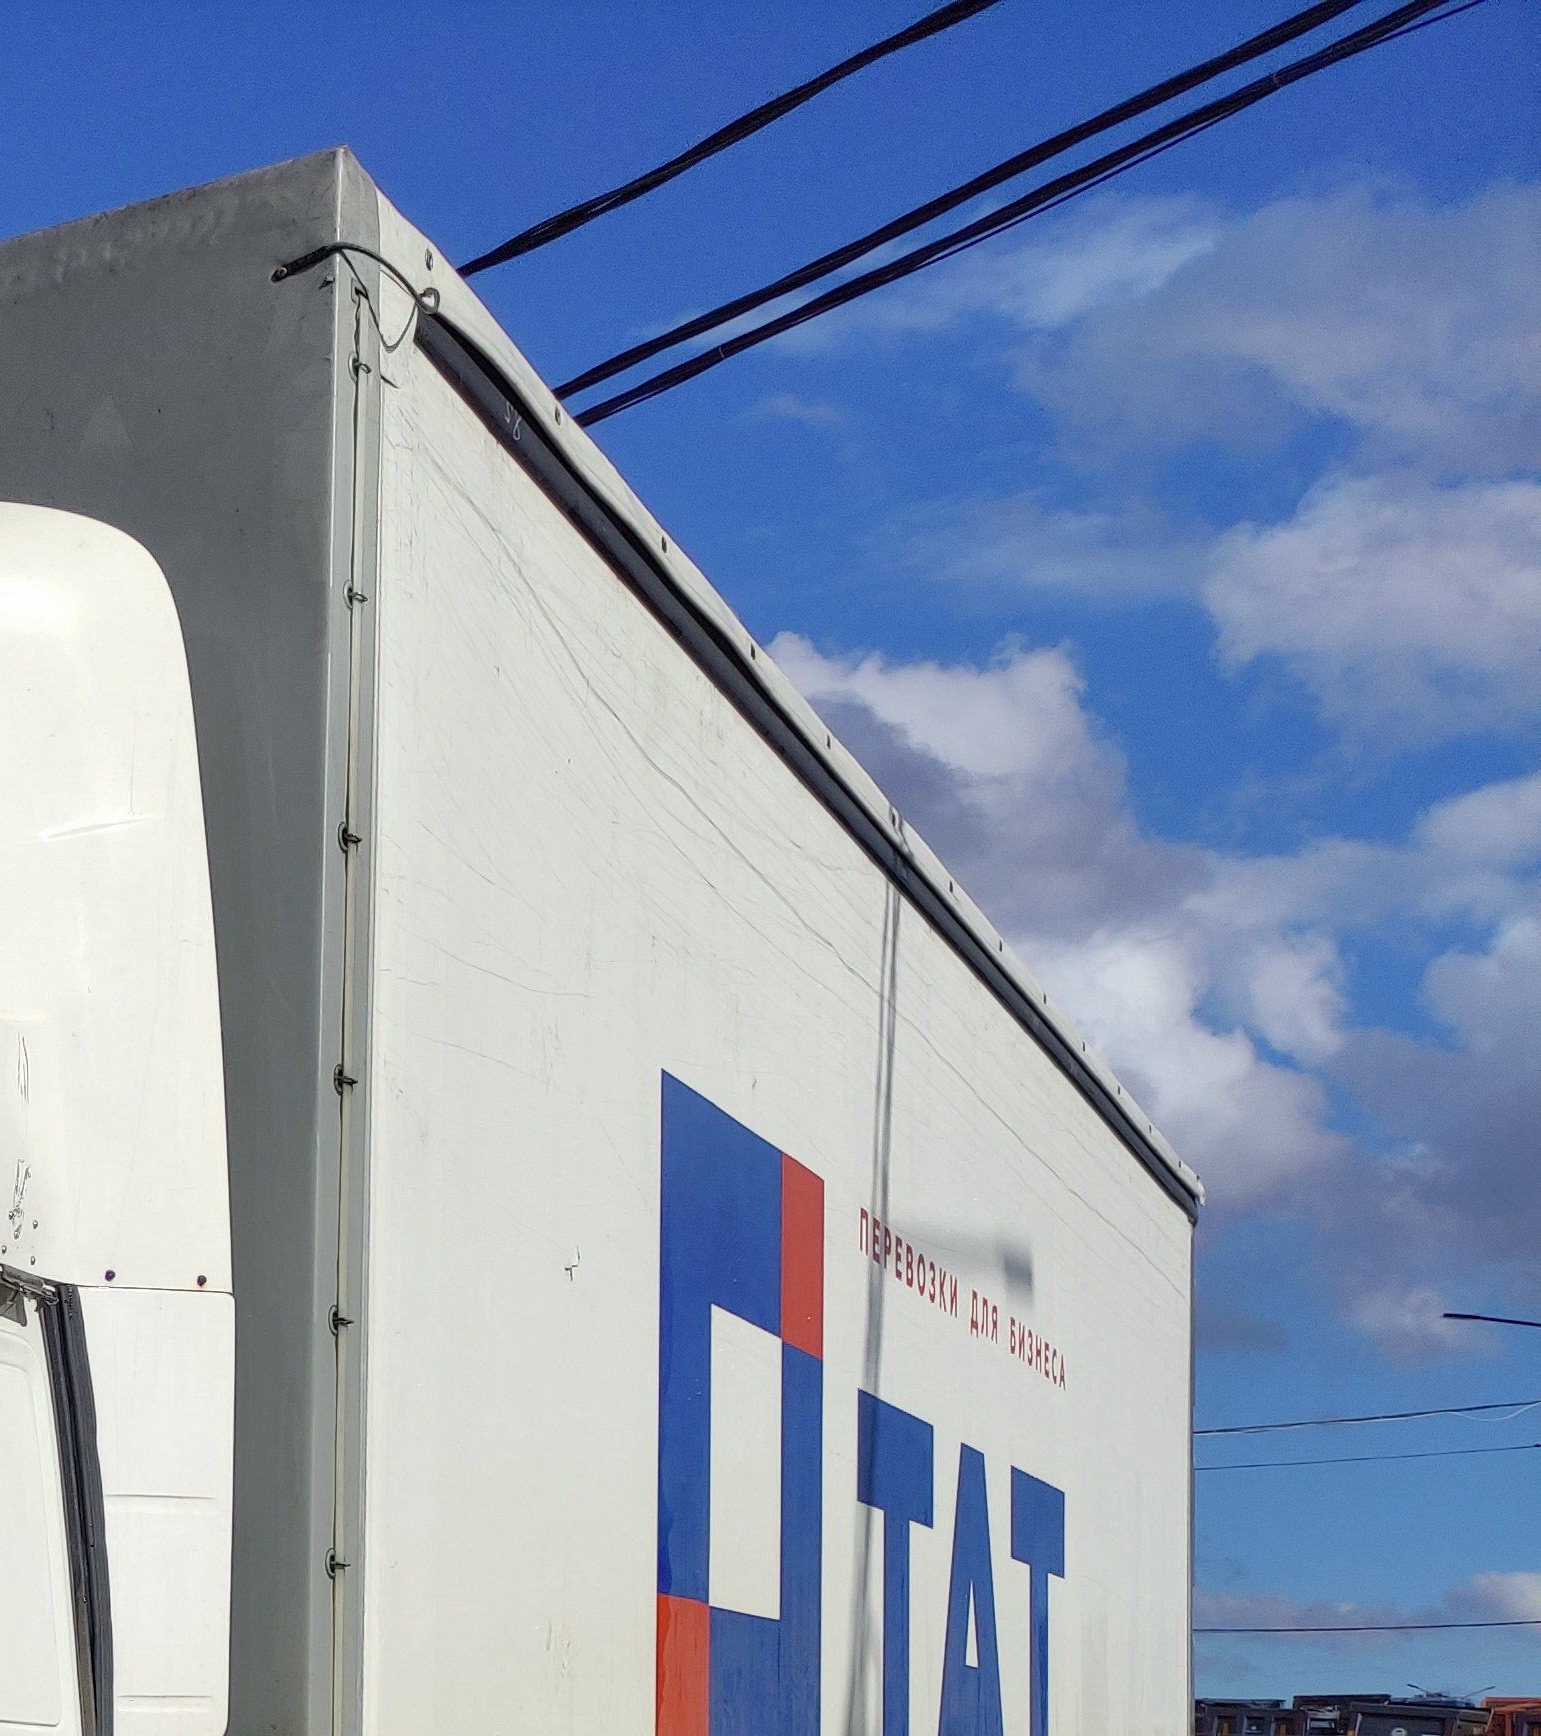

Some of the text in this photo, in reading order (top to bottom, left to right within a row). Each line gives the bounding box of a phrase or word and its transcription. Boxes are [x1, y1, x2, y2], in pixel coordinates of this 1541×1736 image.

[859, 1207, 1066, 1391] ПЕРЕВОЗКИ ДЛЯ БИЗНЕСА
